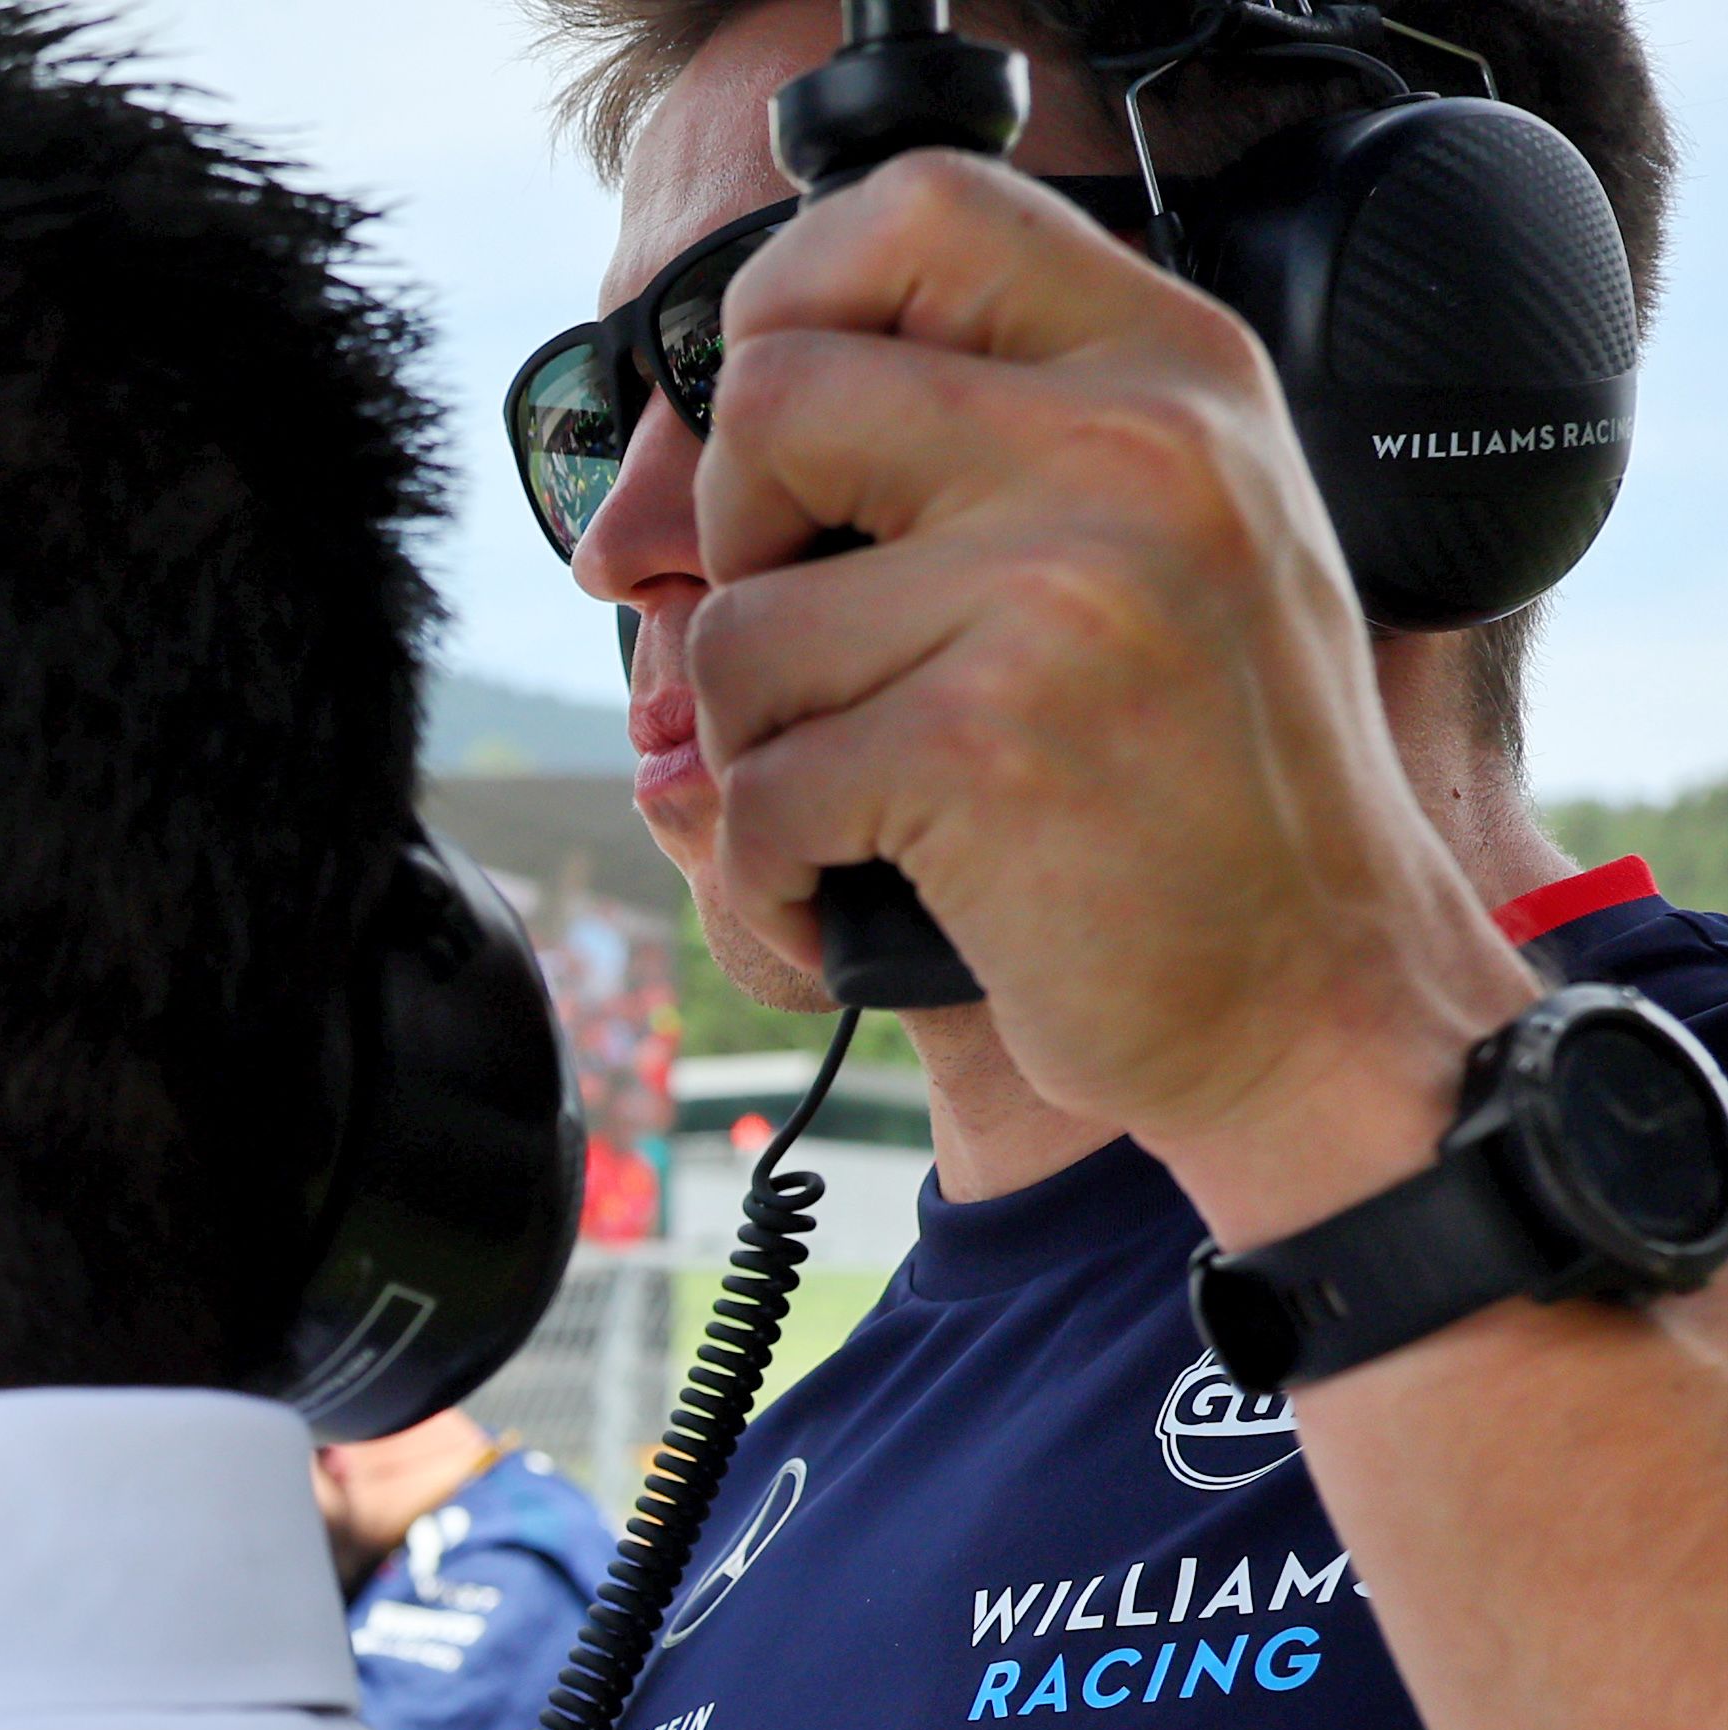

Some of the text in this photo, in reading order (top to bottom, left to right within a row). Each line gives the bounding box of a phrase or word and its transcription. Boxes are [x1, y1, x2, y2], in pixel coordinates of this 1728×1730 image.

[1372, 424, 1555, 459] WILLIAMS
[971, 1550, 1373, 1647] WILLIAM
[967, 1626, 1321, 1721] RACING
